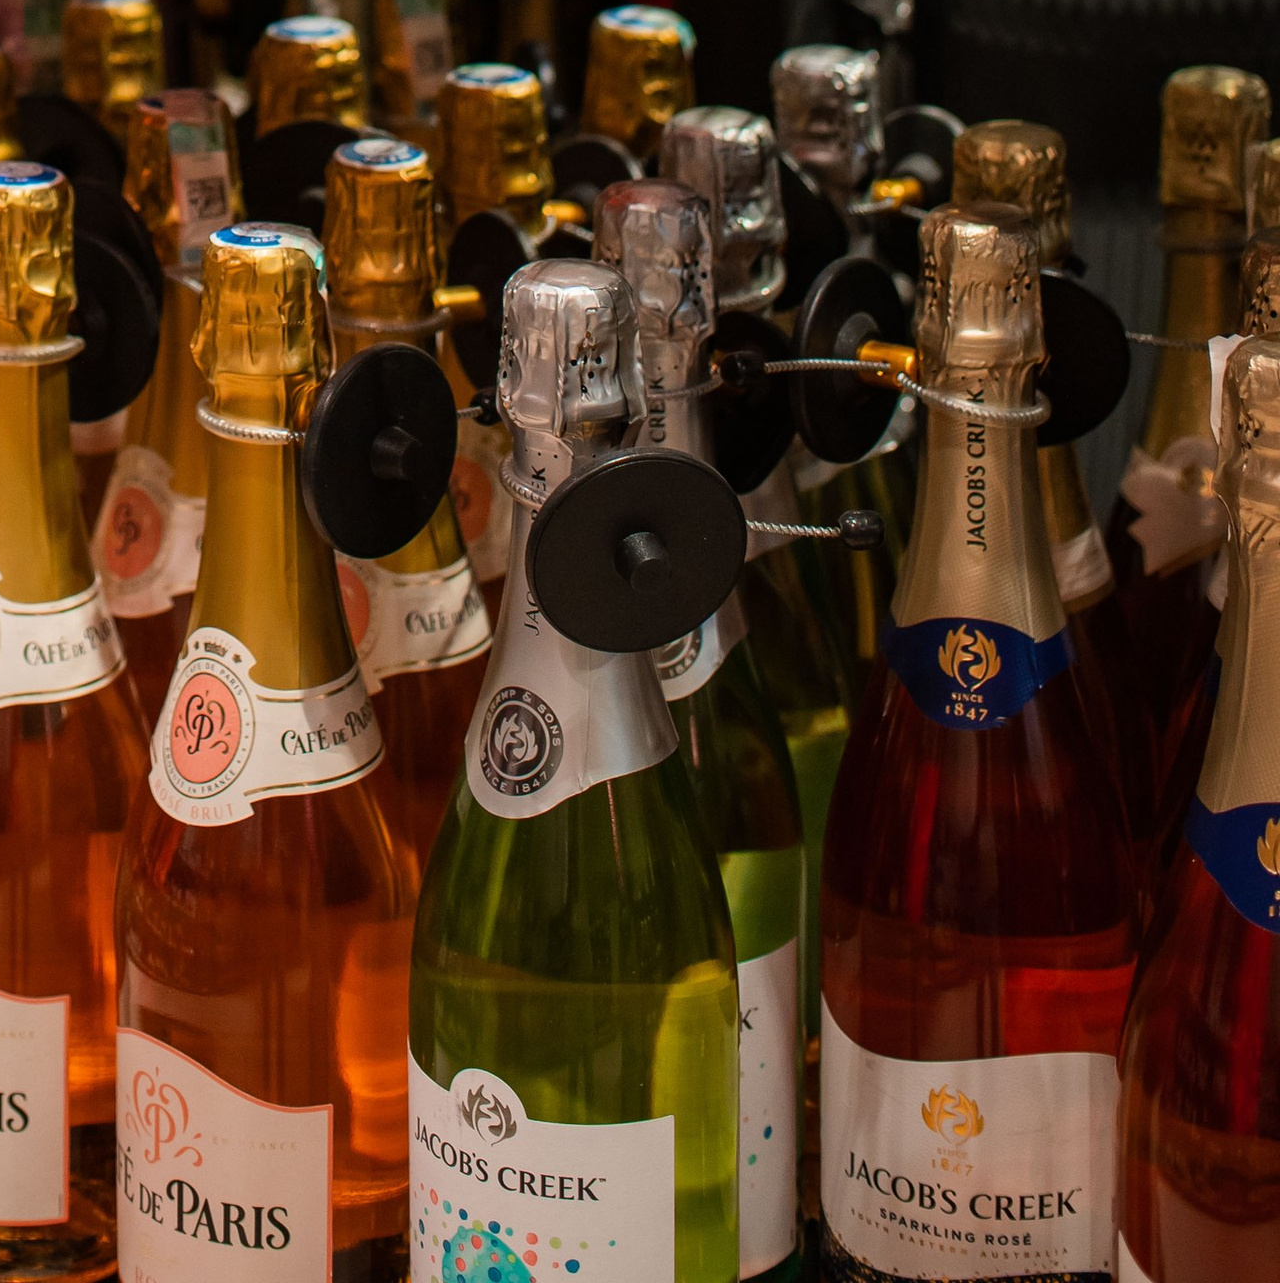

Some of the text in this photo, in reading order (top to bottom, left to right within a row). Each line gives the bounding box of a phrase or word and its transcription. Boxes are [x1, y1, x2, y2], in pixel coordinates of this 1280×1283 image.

[965, 465, 988, 552] JACOB'S
[219, 668, 244, 697] PARIS
[951, 692, 984, 704] SINCE
[522, 691, 532, 704] &
[537, 703, 561, 747] SONS
[945, 702, 989, 722] 1847
[281, 723, 349, 756] CAFÉ DE
[201, 769, 236, 795] FRANCE
[480, 750, 548, 794] SINCE 1847
[190, 802, 234, 821] BRUT
[414, 1115, 601, 1202] JACOB'S CREEK
[931, 1157, 974, 1177] 1847
[844, 1150, 1078, 1222] JACOB'S CREEK
[139, 1182, 164, 1225] DE
[165, 1178, 291, 1250] PARIS
[879, 1207, 1033, 1247] SPARKLING ROSÉ
[898, 1232, 969, 1256] EASTERN
[979, 1246, 1069, 1260] AUSTRALIA
